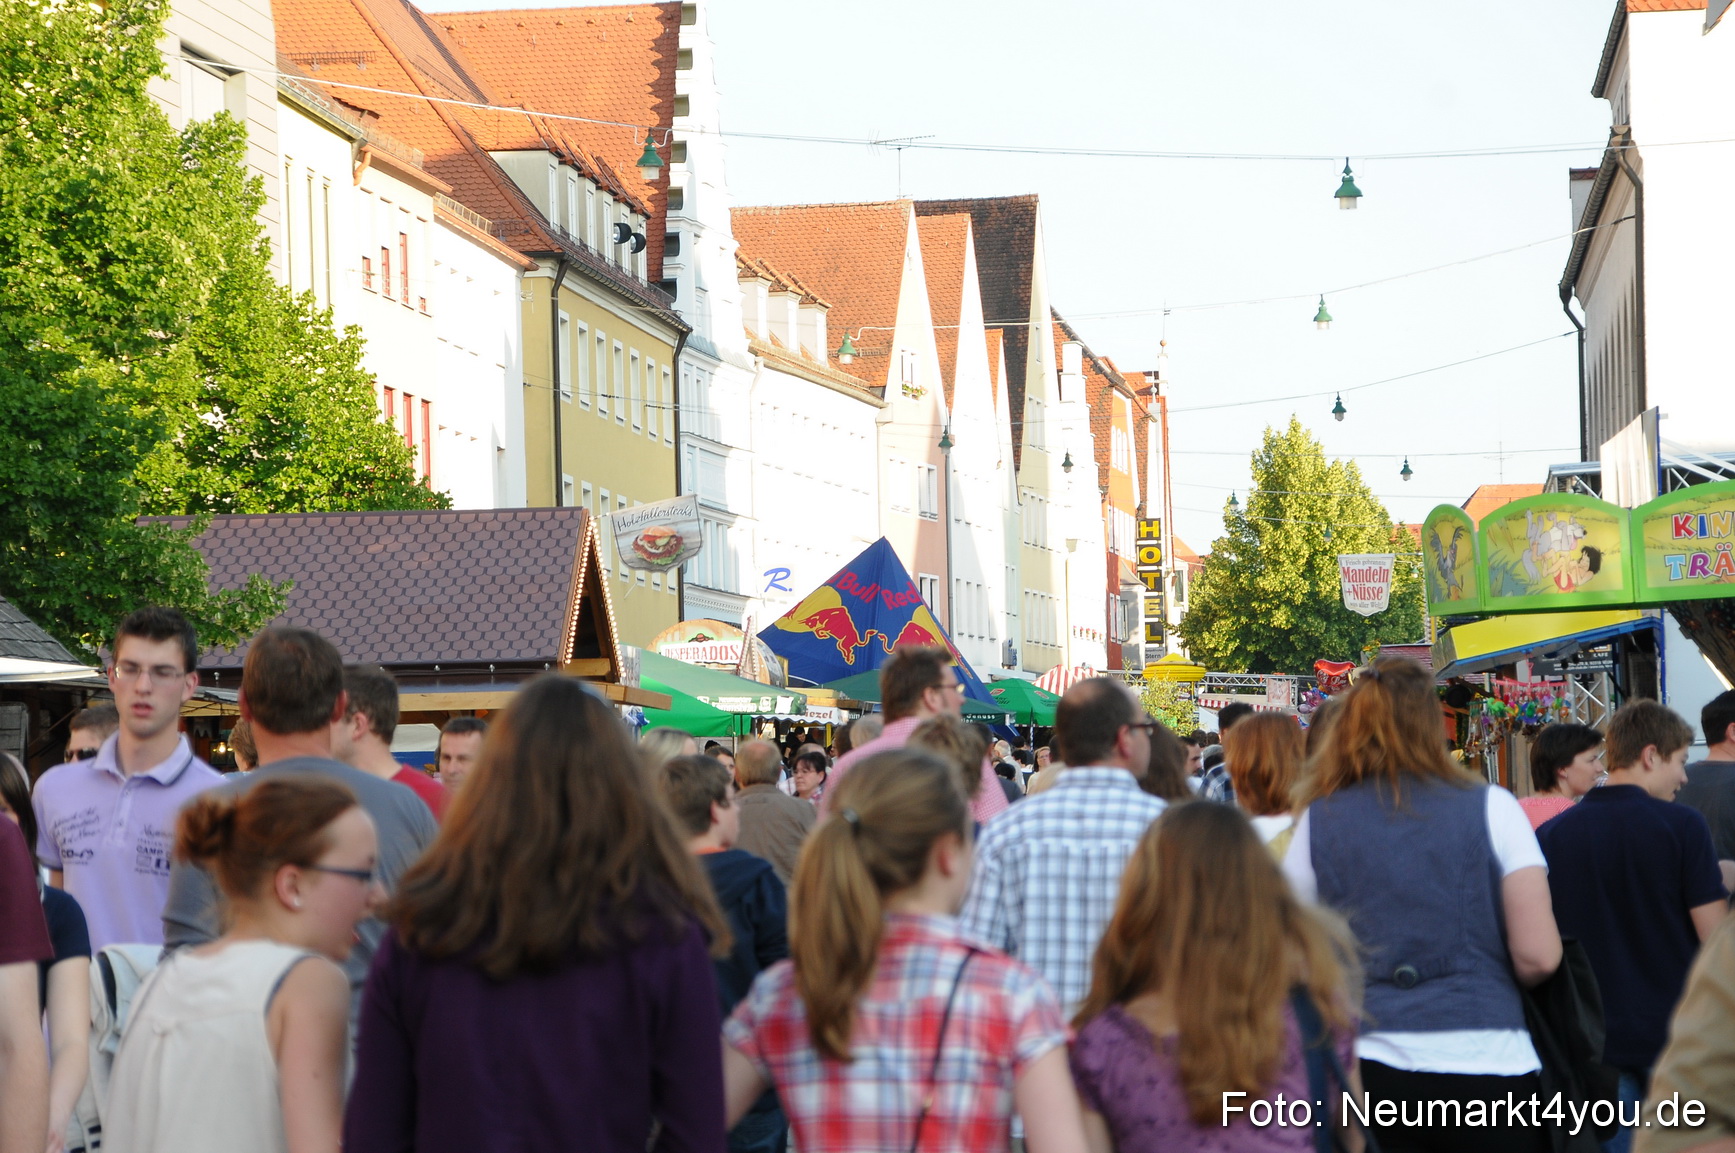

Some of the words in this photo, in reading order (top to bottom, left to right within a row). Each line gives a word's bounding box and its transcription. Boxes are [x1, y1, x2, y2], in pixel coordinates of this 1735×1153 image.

[1672, 511, 1735, 540] KIN
[836, 571, 881, 604] Bull
[1139, 520, 1162, 641] HOTEL
[1341, 566, 1390, 583] Mandeln
[880, 581, 922, 611] Red
[664, 645, 740, 661] DESPERADOS
